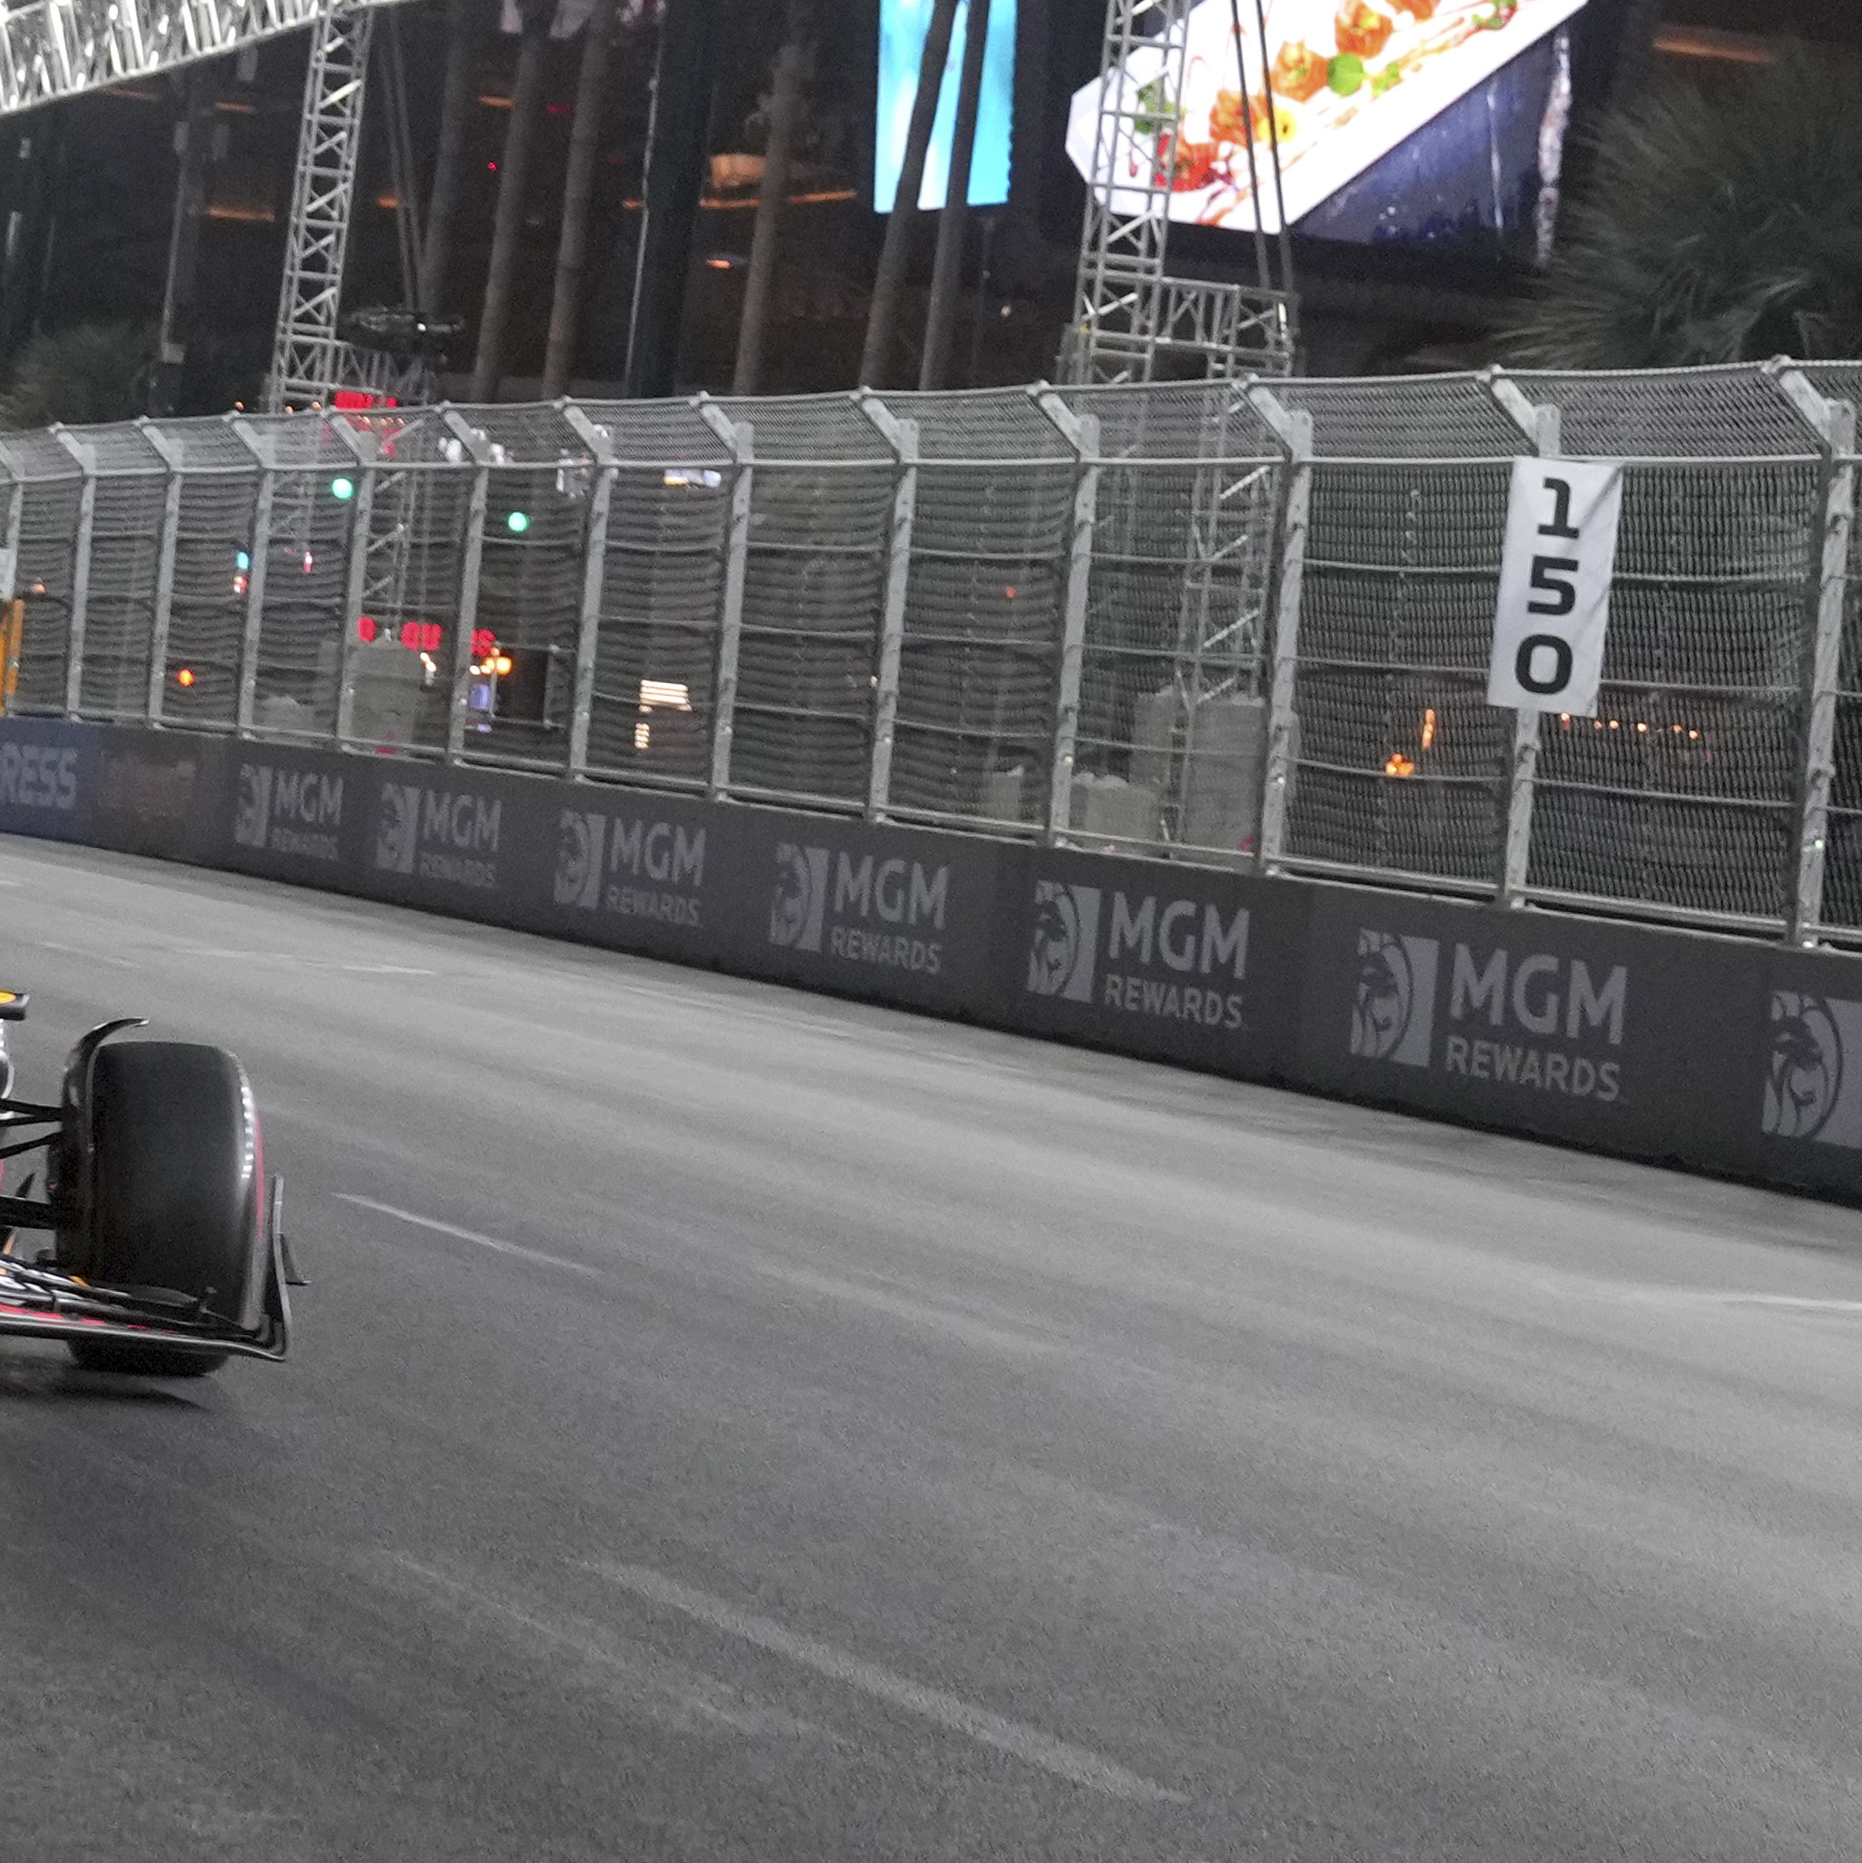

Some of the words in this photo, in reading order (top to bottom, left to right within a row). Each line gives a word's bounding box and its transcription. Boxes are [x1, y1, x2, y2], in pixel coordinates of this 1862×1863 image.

[1513, 477, 1580, 696] 150
[274, 770, 343, 826] MGM
[423, 789, 502, 852] MGM
[610, 817, 706, 887] MGM
[606, 883, 701, 928] REWARDS
[832, 854, 950, 931] MGM
[830, 925, 943, 974] REWARDS
[1107, 891, 1251, 981] MGM
[1104, 973, 1246, 1031] REWARDS
[1450, 942, 1629, 1046] MGM
[1445, 1035, 1623, 1104] REWARDS
